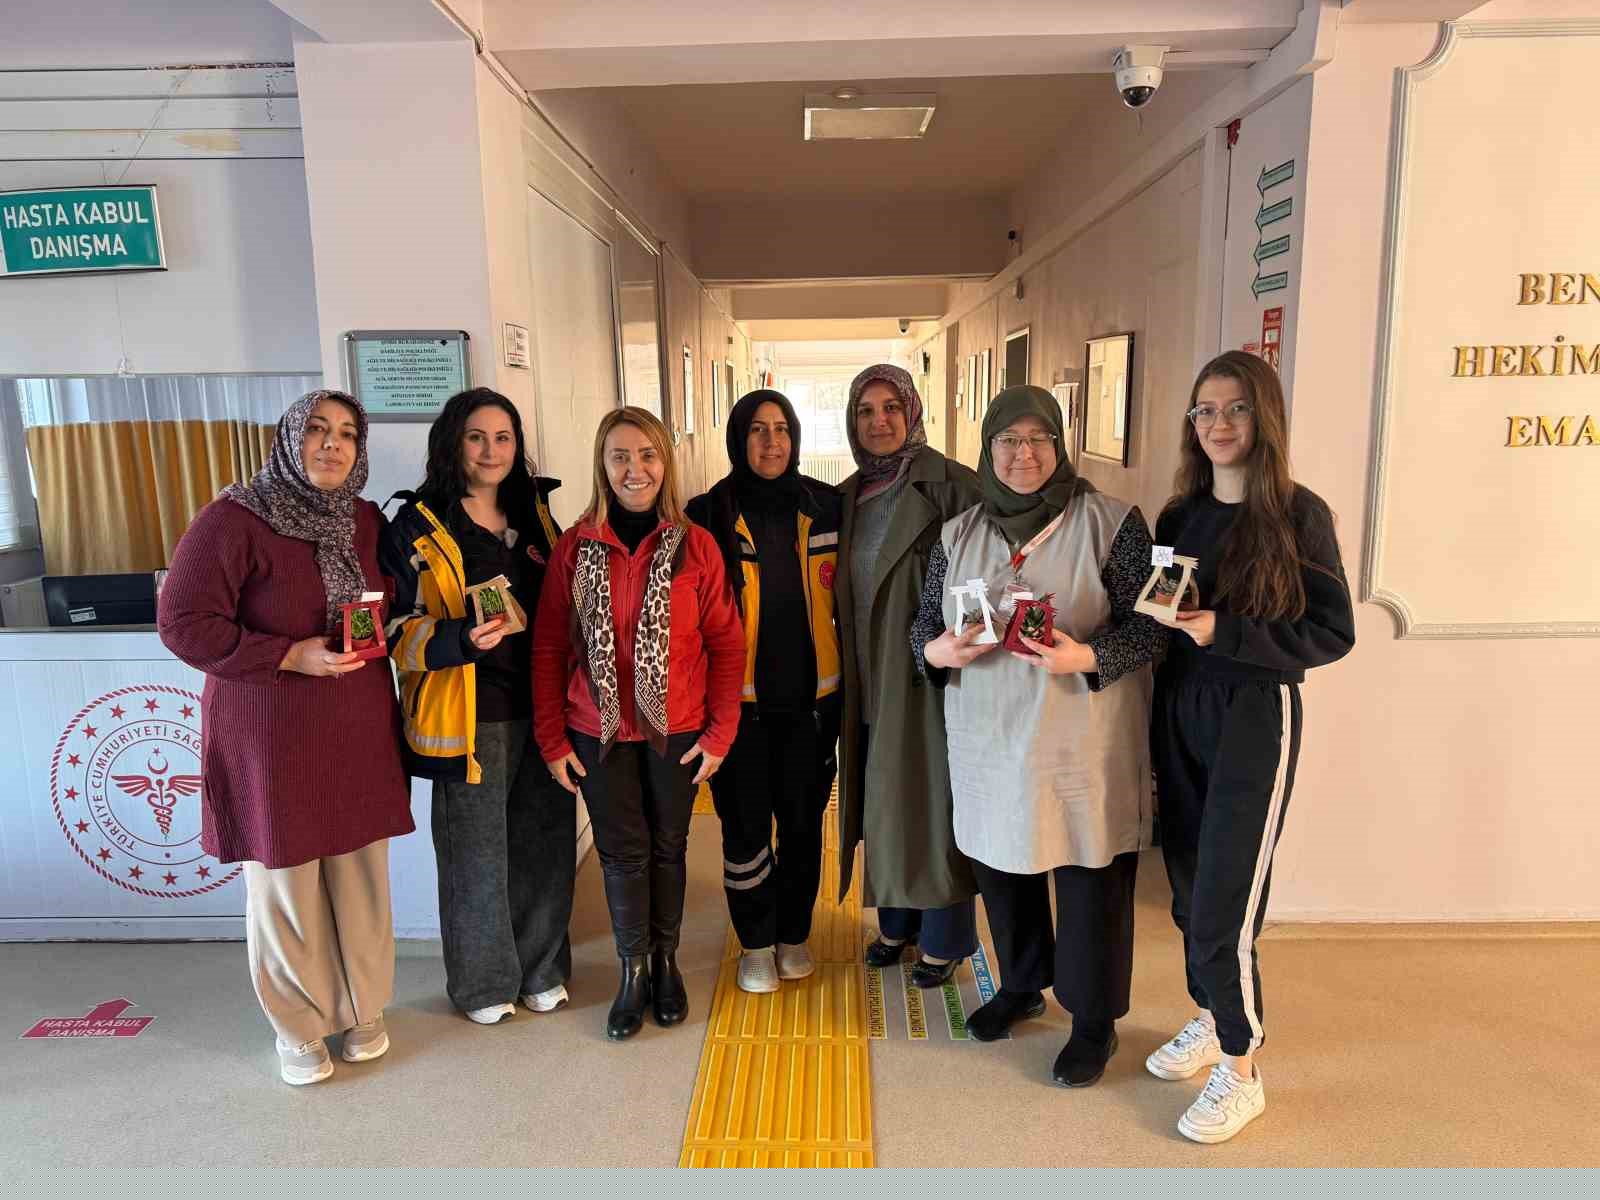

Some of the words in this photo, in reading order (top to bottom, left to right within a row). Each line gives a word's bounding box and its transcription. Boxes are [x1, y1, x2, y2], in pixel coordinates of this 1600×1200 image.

[3, 204, 70, 229] HASTA
[73, 201, 148, 225] KABUL
[29, 233, 128, 260] DANIŞMA
[92, 725, 168, 789] CUMHURİYETİ
[94, 795, 137, 851] TÜRKİYE
[40, 1019, 90, 1028] HASTA
[94, 1019, 142, 1028] KABUL
